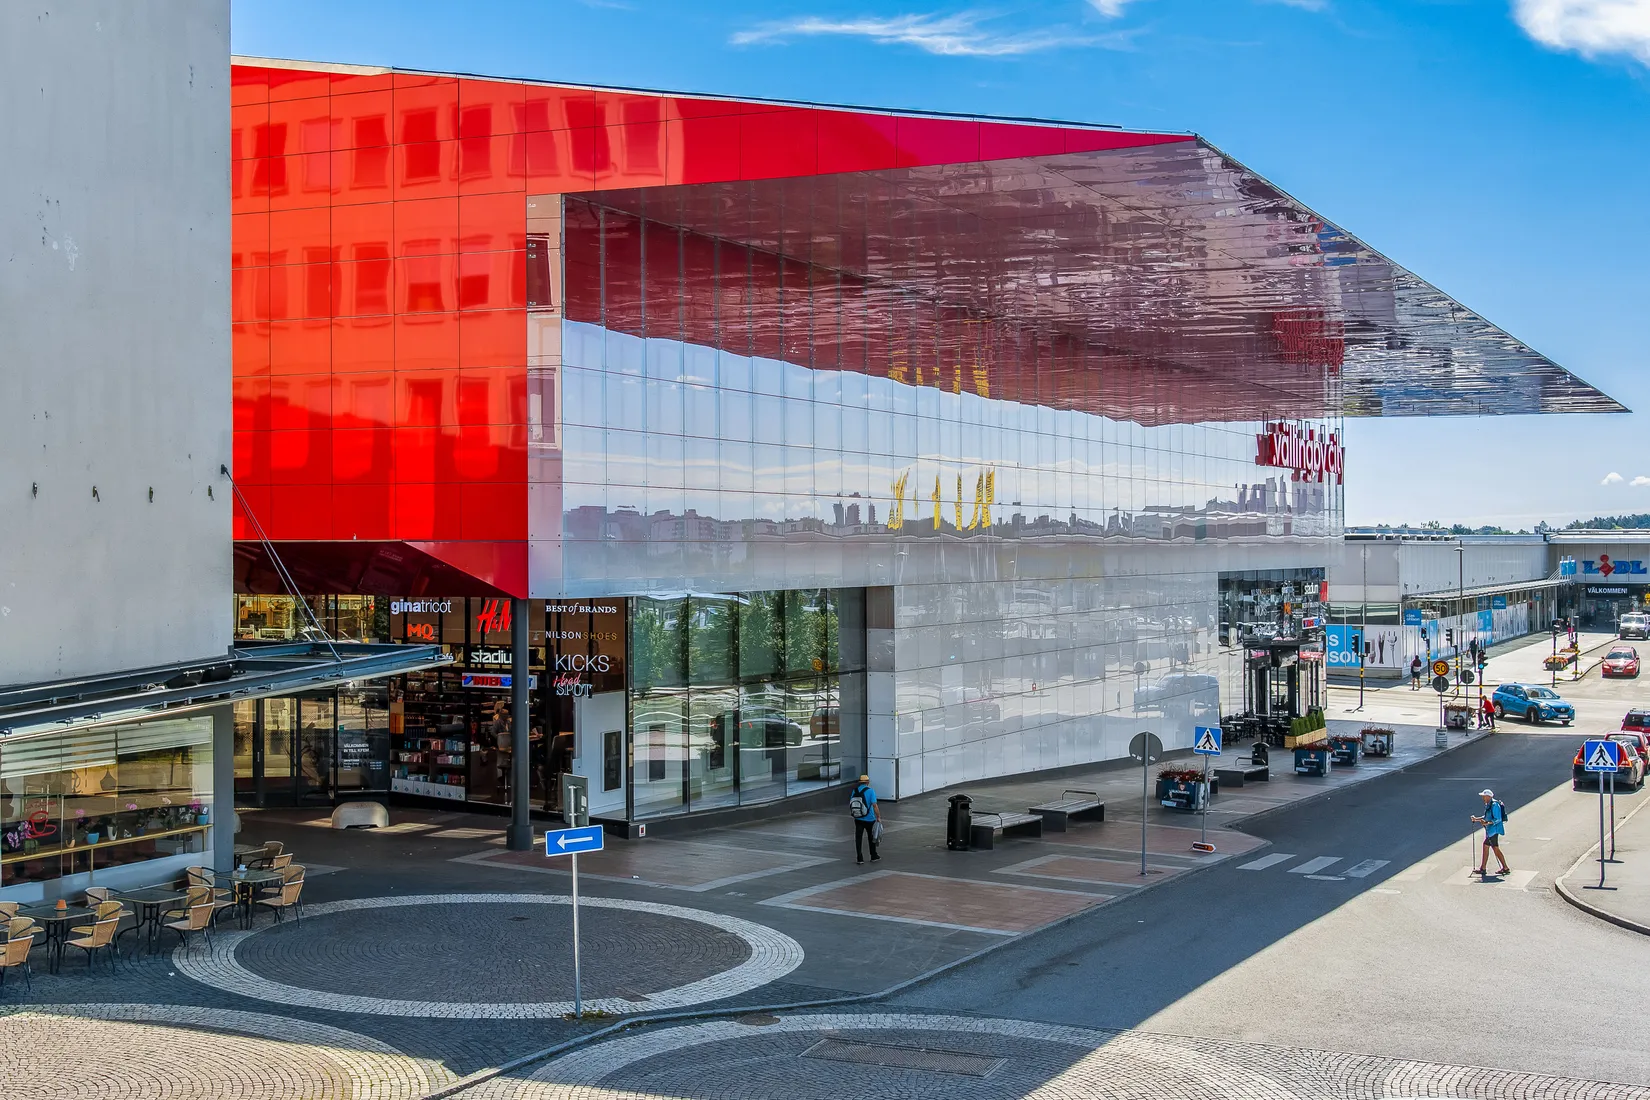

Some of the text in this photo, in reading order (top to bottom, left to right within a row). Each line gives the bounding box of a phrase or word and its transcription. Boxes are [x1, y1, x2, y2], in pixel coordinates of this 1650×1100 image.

[545, 602, 617, 616] BEST of BRANDS
[407, 623, 435, 641] MQ
[470, 649, 513, 664] stadiu
[555, 654, 610, 672] KICKS
[1435, 664, 1446, 673] 50
[556, 682, 593, 697] SPOT
